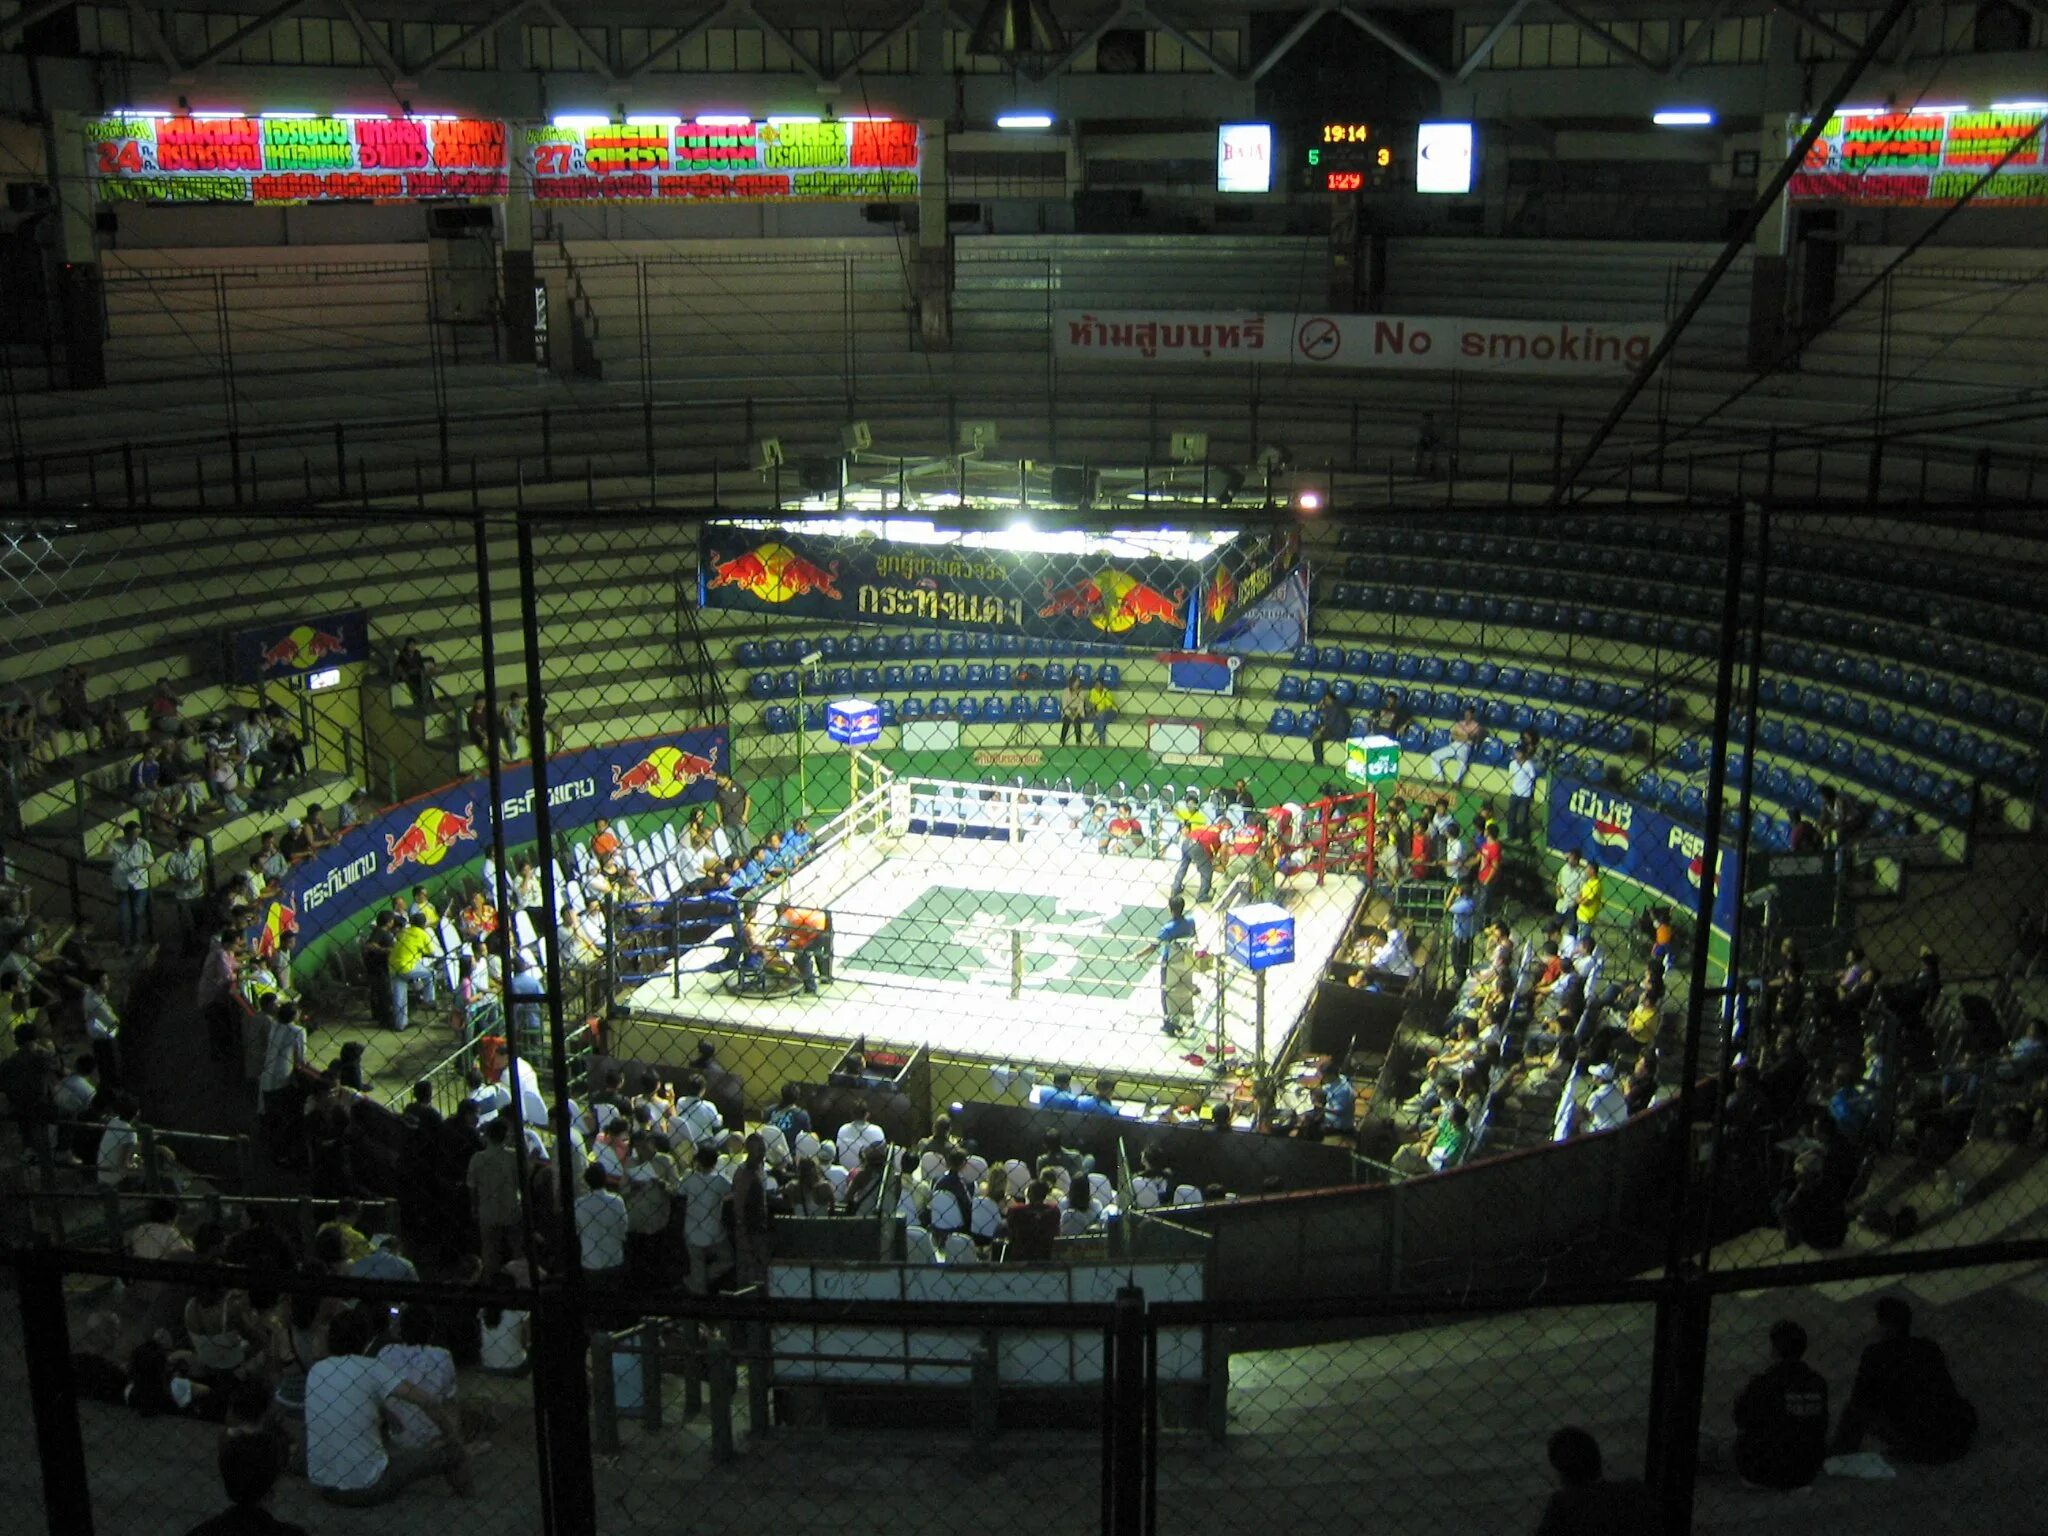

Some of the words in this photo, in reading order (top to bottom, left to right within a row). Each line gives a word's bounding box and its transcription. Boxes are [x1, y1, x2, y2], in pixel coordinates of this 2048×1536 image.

[1323, 125, 1367, 142] 19:14
[99, 141, 142, 173] 24
[534, 145, 572, 174] 27
[1377, 148, 1390, 166] 3
[1374, 321, 1432, 355] No
[1460, 325, 1651, 371] smoking
[1668, 825, 1723, 876] PEPI
[303, 851, 377, 912] กระทิงแดง
